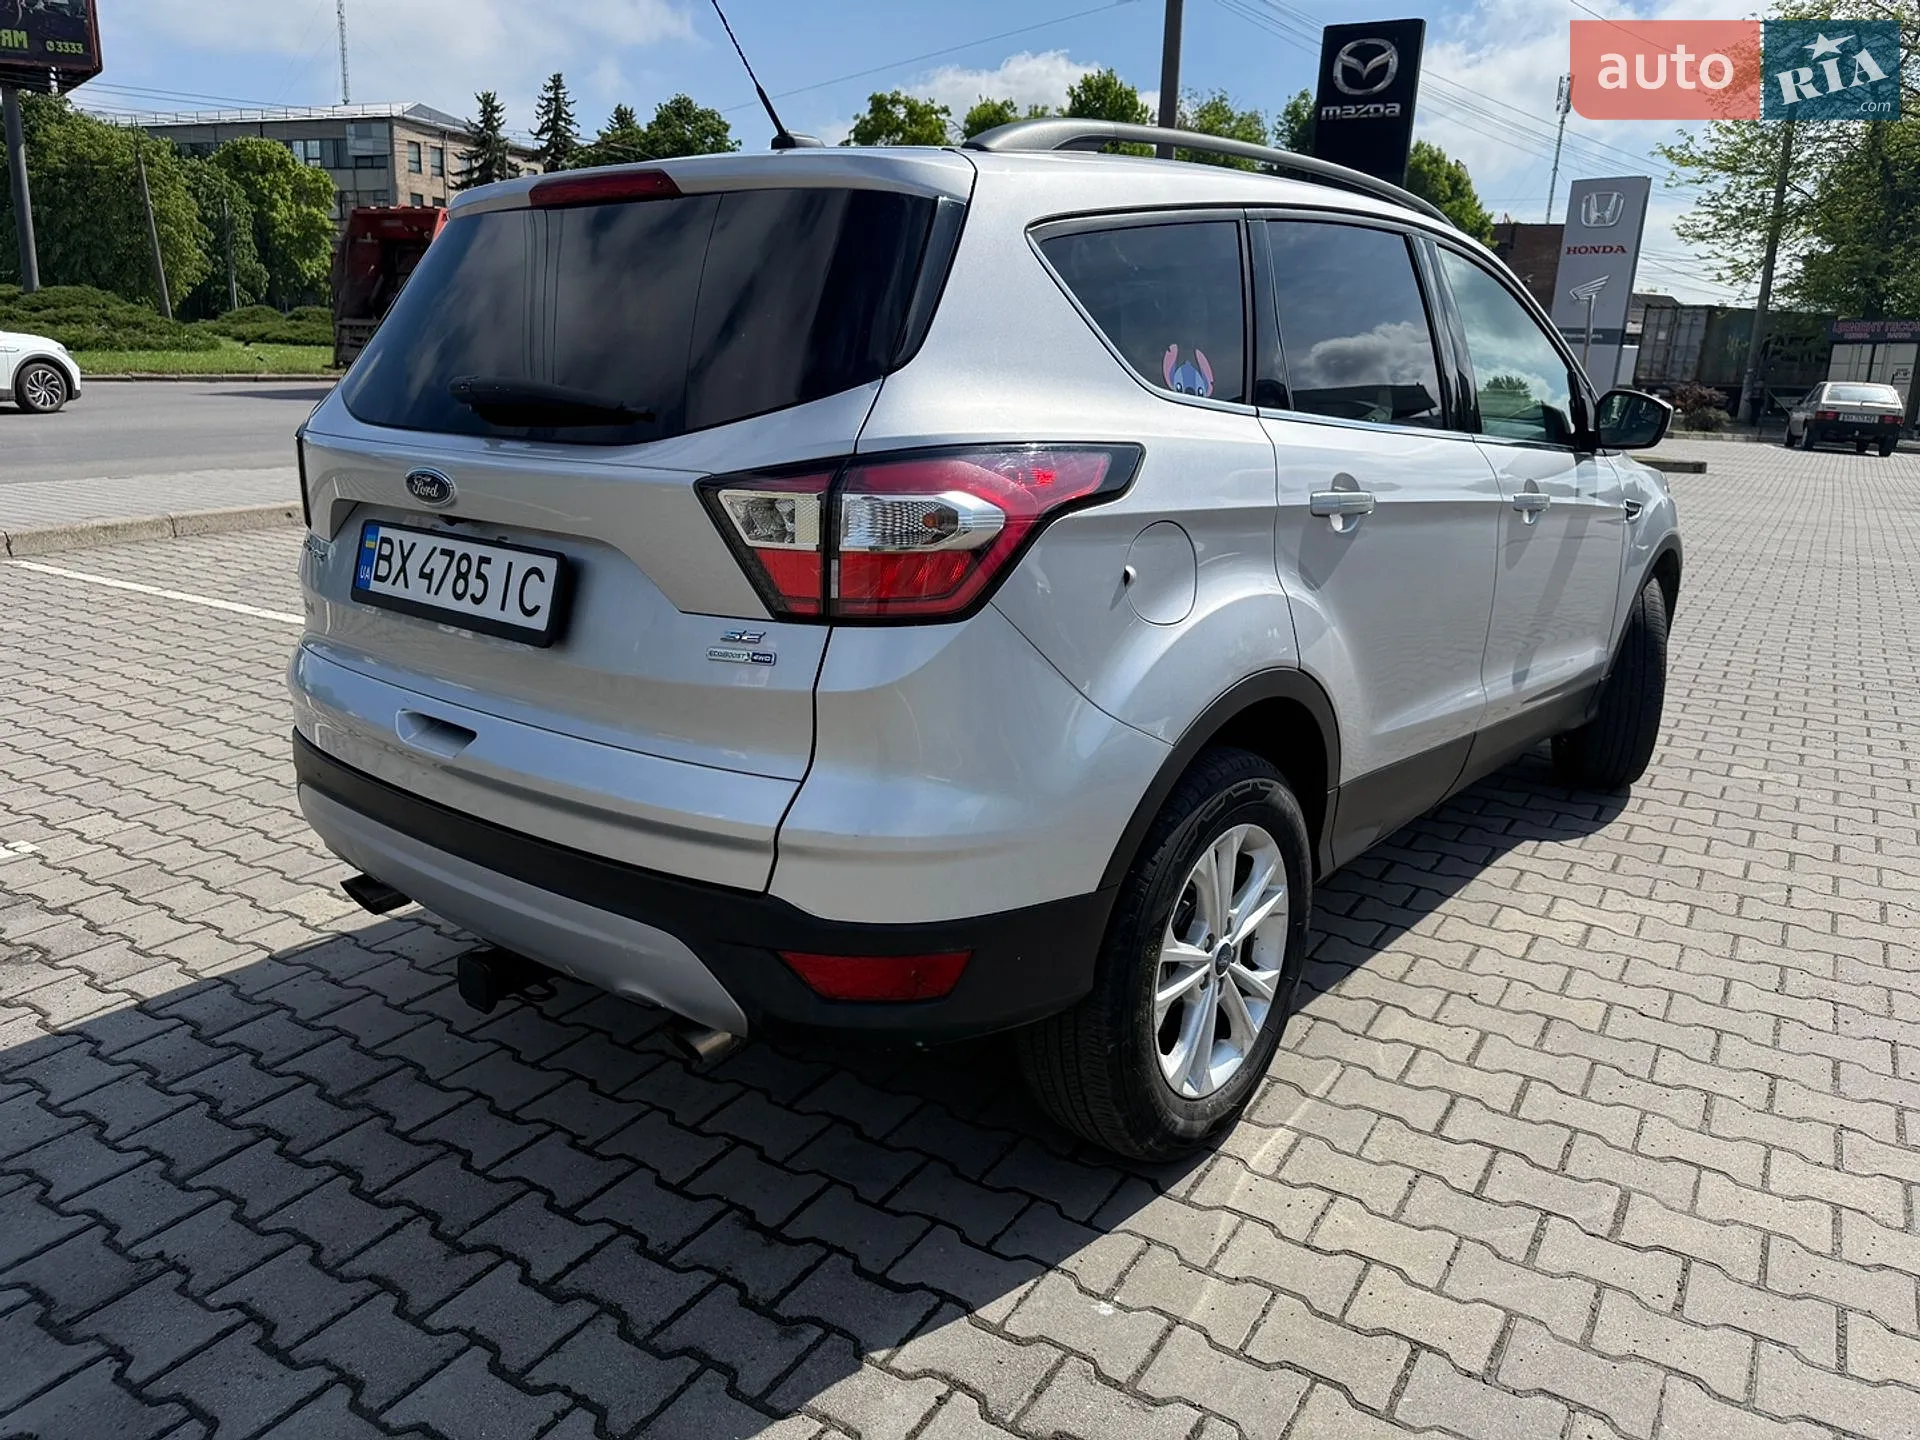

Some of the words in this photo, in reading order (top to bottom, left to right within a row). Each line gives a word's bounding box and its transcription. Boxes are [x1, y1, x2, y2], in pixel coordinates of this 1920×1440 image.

[1321, 103, 1400, 120] mazda
[1566, 245, 1627, 255] HONDA
[412, 476, 439, 498] Ford
[360, 565, 371, 580] UA
[373, 536, 416, 588] BX
[418, 546, 492, 605] 4785
[500, 561, 545, 617] IC
